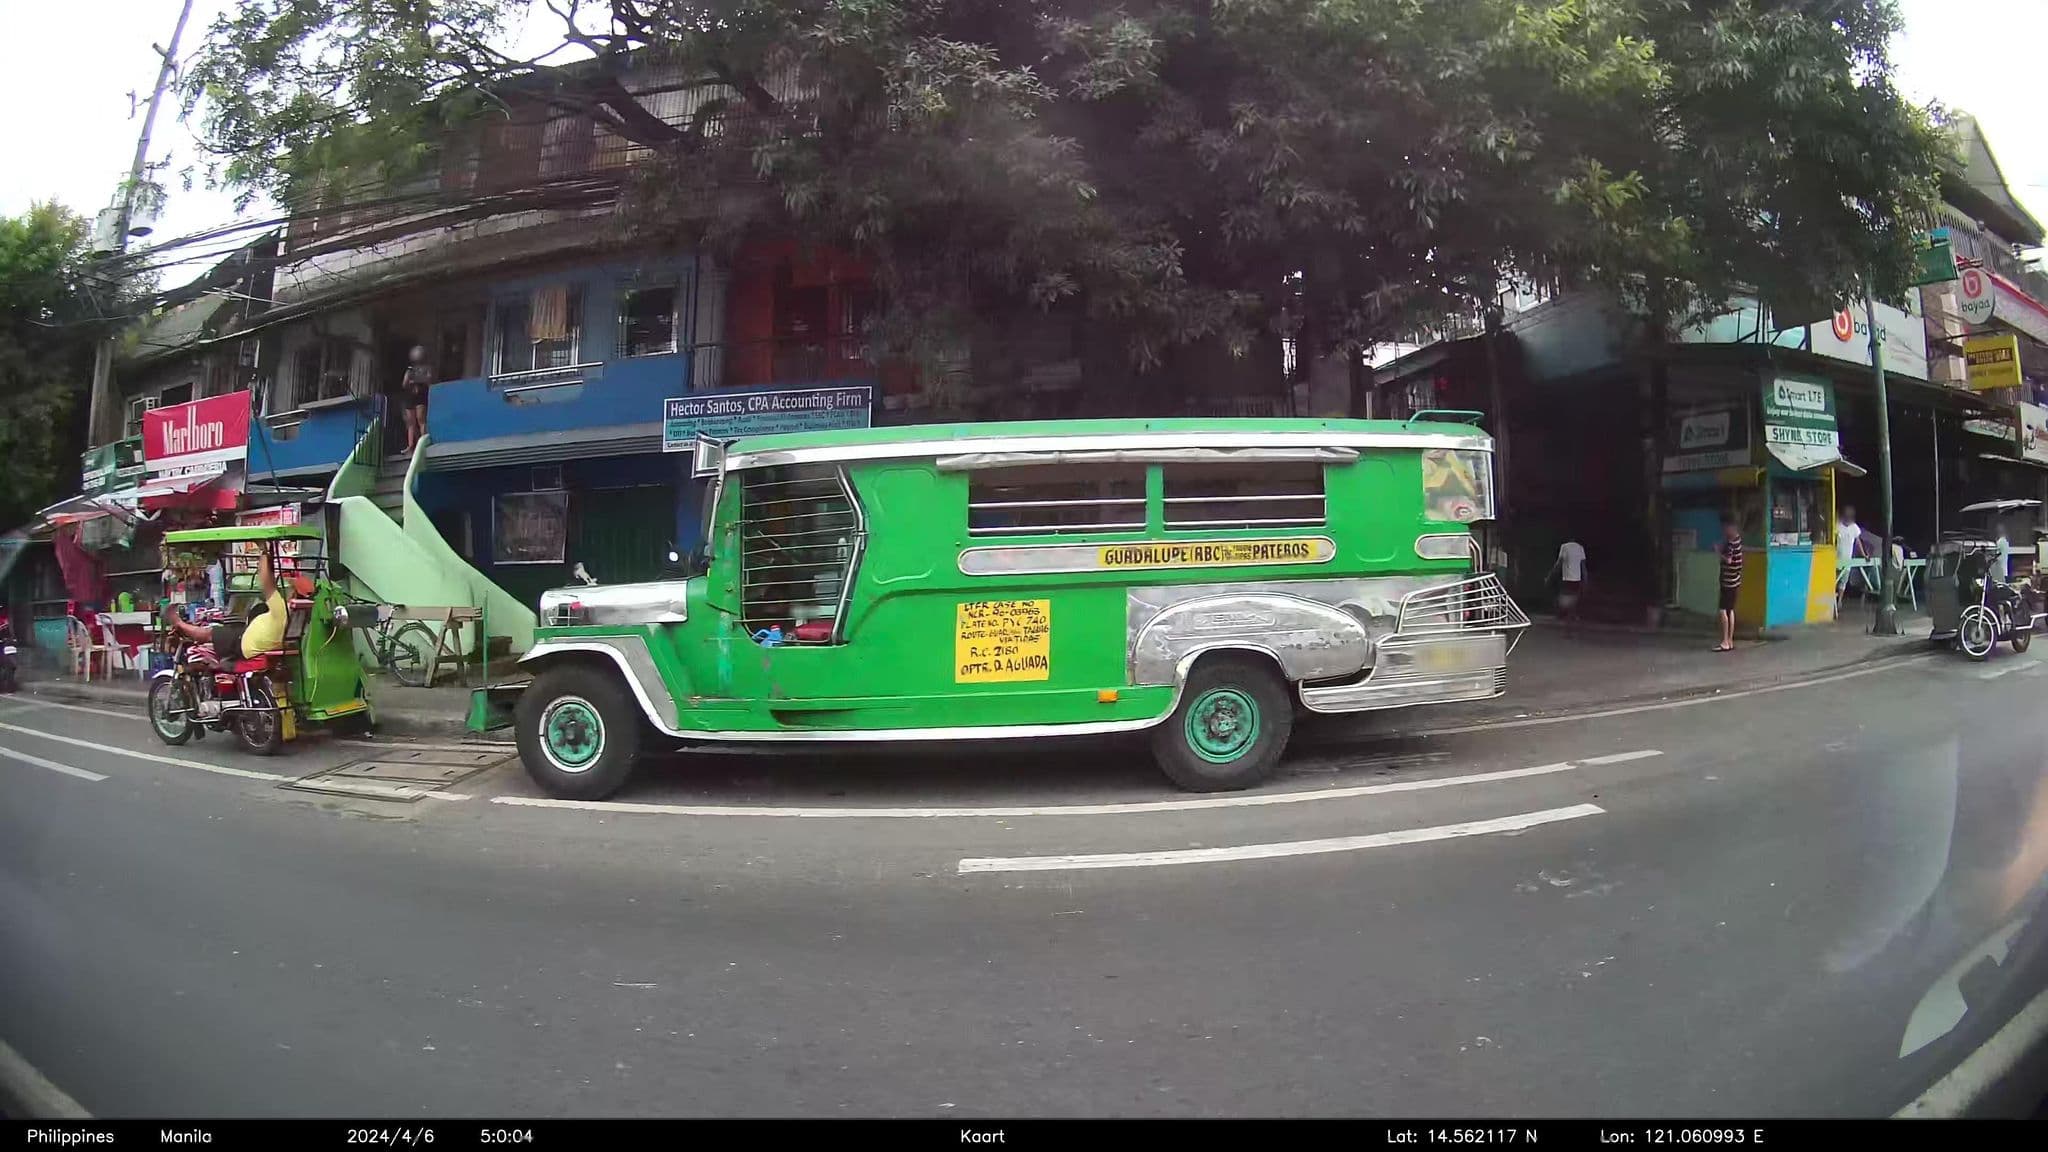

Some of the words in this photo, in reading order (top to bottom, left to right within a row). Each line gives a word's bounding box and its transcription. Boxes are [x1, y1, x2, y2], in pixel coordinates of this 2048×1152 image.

[1962, 300, 1990, 312] bayad
[1855, 321, 1886, 341] bad
[671, 402, 704, 417] Hector
[707, 399, 745, 414] Santos,
[748, 396, 768, 411] CPA
[772, 392, 833, 410] Accounting
[836, 391, 862, 406] Firm
[1808, 390, 1821, 403] LTE
[163, 405, 223, 455] Marlboro
[1807, 431, 1832, 445] STORE
[1105, 547, 1187, 565] GUADALUPE
[1253, 543, 1310, 560] PATEROS
